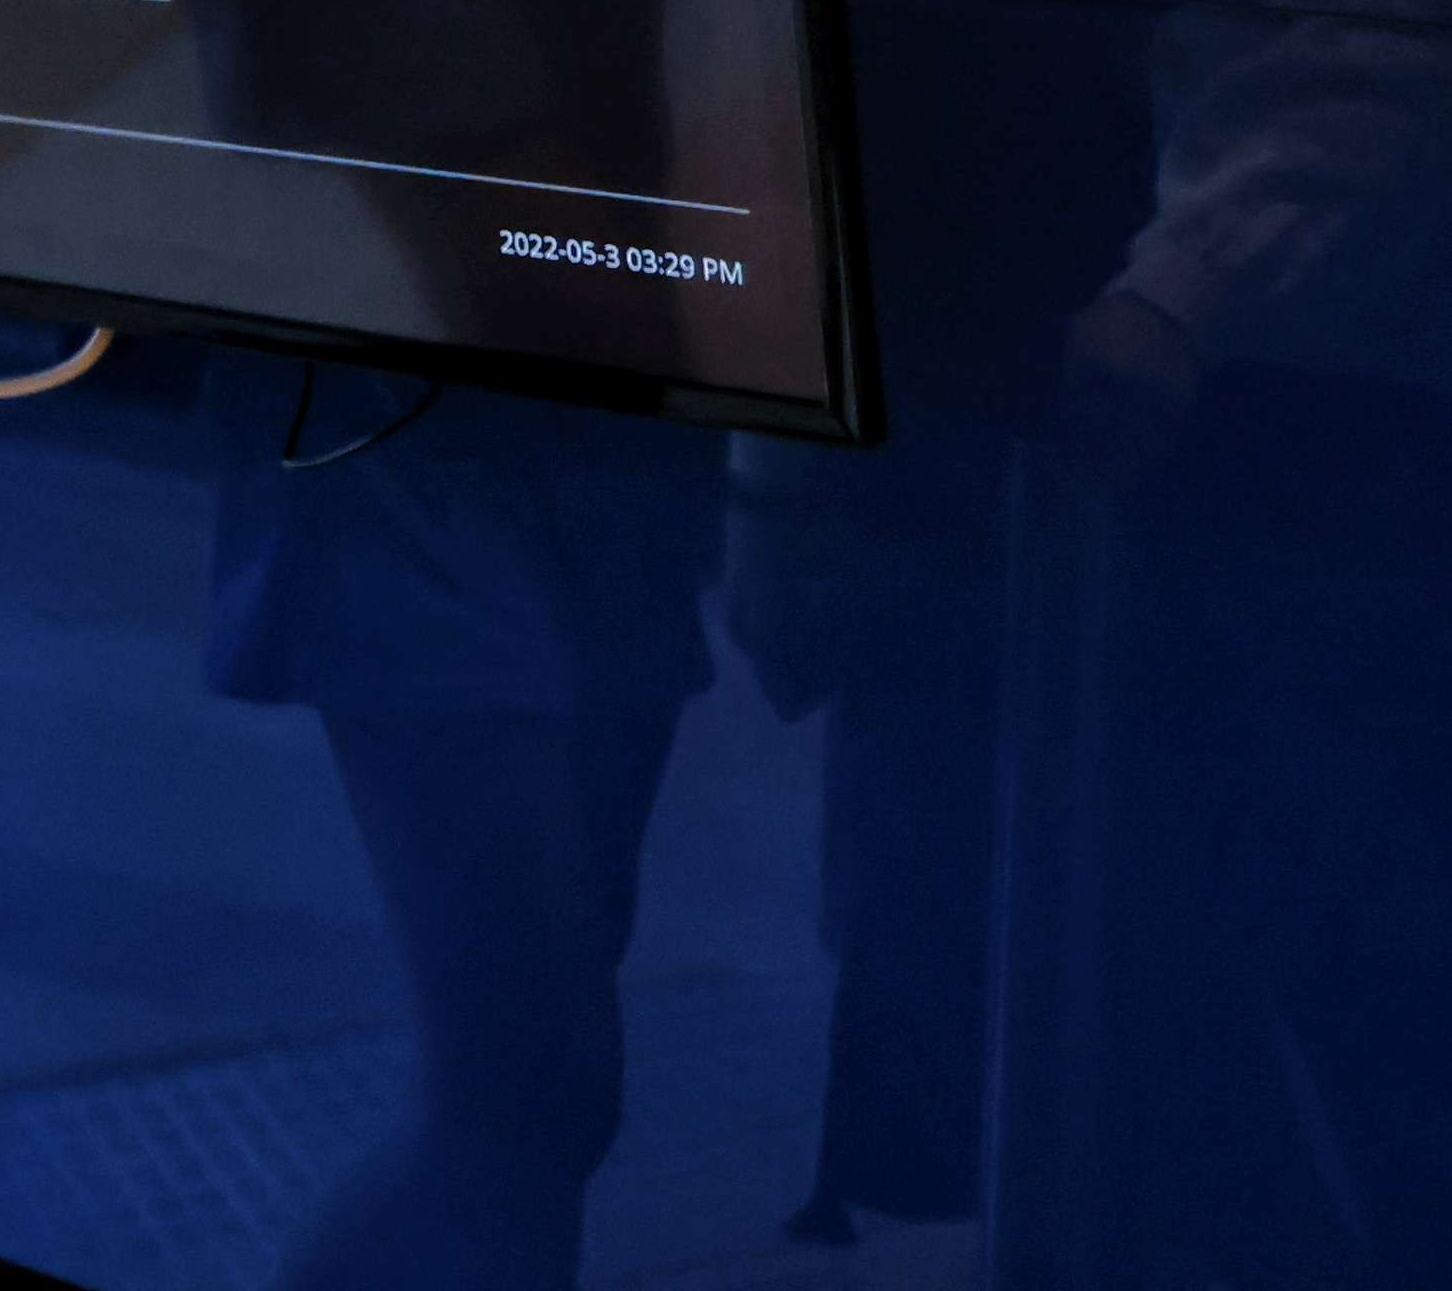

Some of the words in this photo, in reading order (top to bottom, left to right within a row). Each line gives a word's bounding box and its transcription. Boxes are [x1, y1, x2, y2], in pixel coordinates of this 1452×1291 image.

[498, 228, 621, 271] 2022-05-3
[625, 246, 695, 282] 03:29
[701, 255, 744, 286] PM
